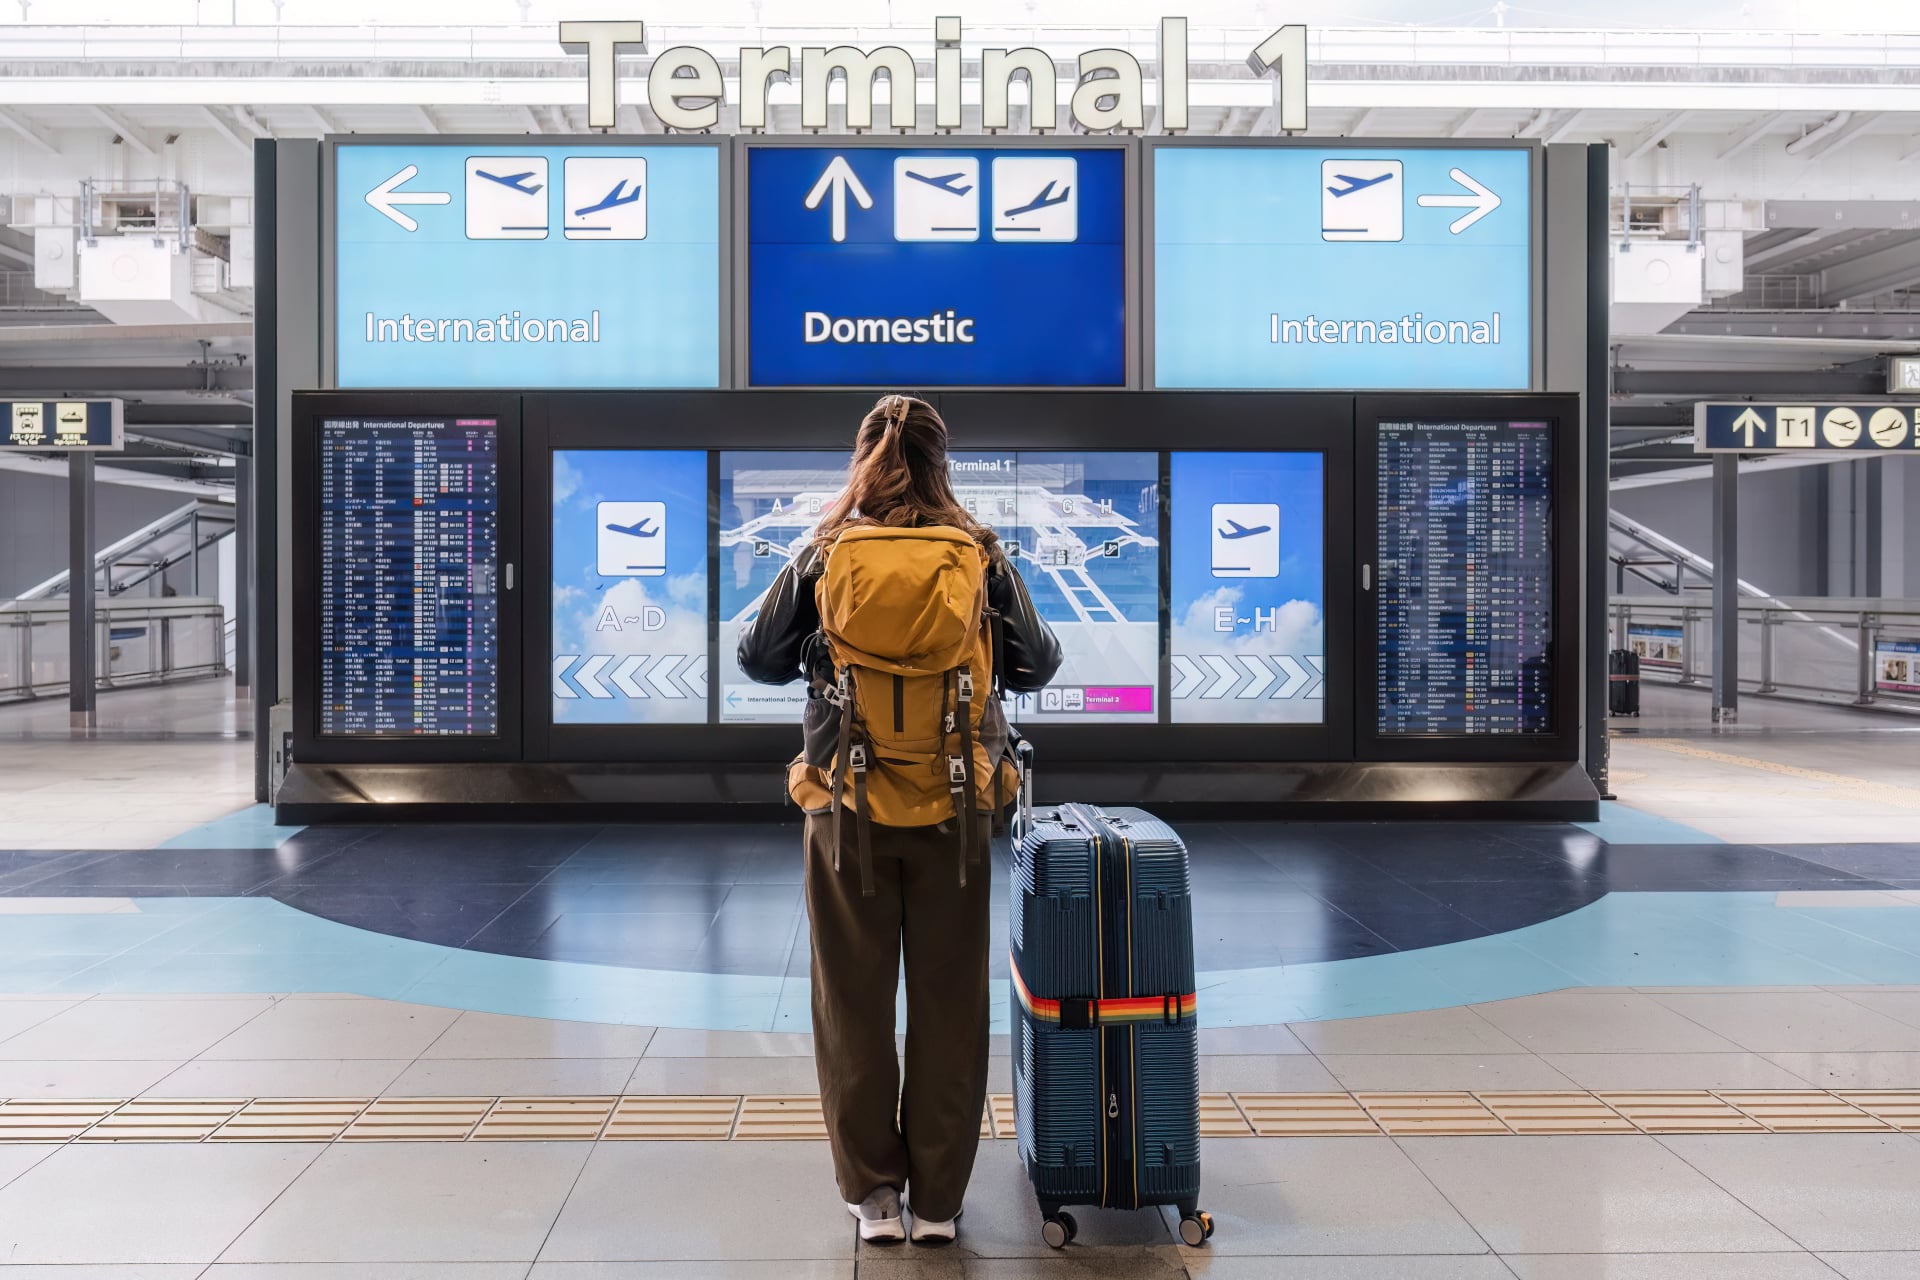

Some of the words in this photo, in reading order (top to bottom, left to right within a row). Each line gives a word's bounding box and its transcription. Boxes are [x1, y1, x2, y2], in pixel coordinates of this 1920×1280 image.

[559, 16, 1188, 131] Terminal
[1247, 24, 1308, 131] 1
[365, 310, 600, 342] International
[804, 310, 975, 345] Domestic
[1270, 312, 1500, 344] International
[363, 421, 406, 429] International
[407, 421, 445, 430] Departures
[1417, 423, 1459, 431] International
[1461, 424, 1497, 432] Departures
[1781, 418, 1809, 437] T1
[949, 459, 1000, 471] Terminal
[771, 497, 783, 513] A
[810, 498, 821, 513] B
[1062, 499, 1074, 514] G
[1100, 498, 1113, 514] H
